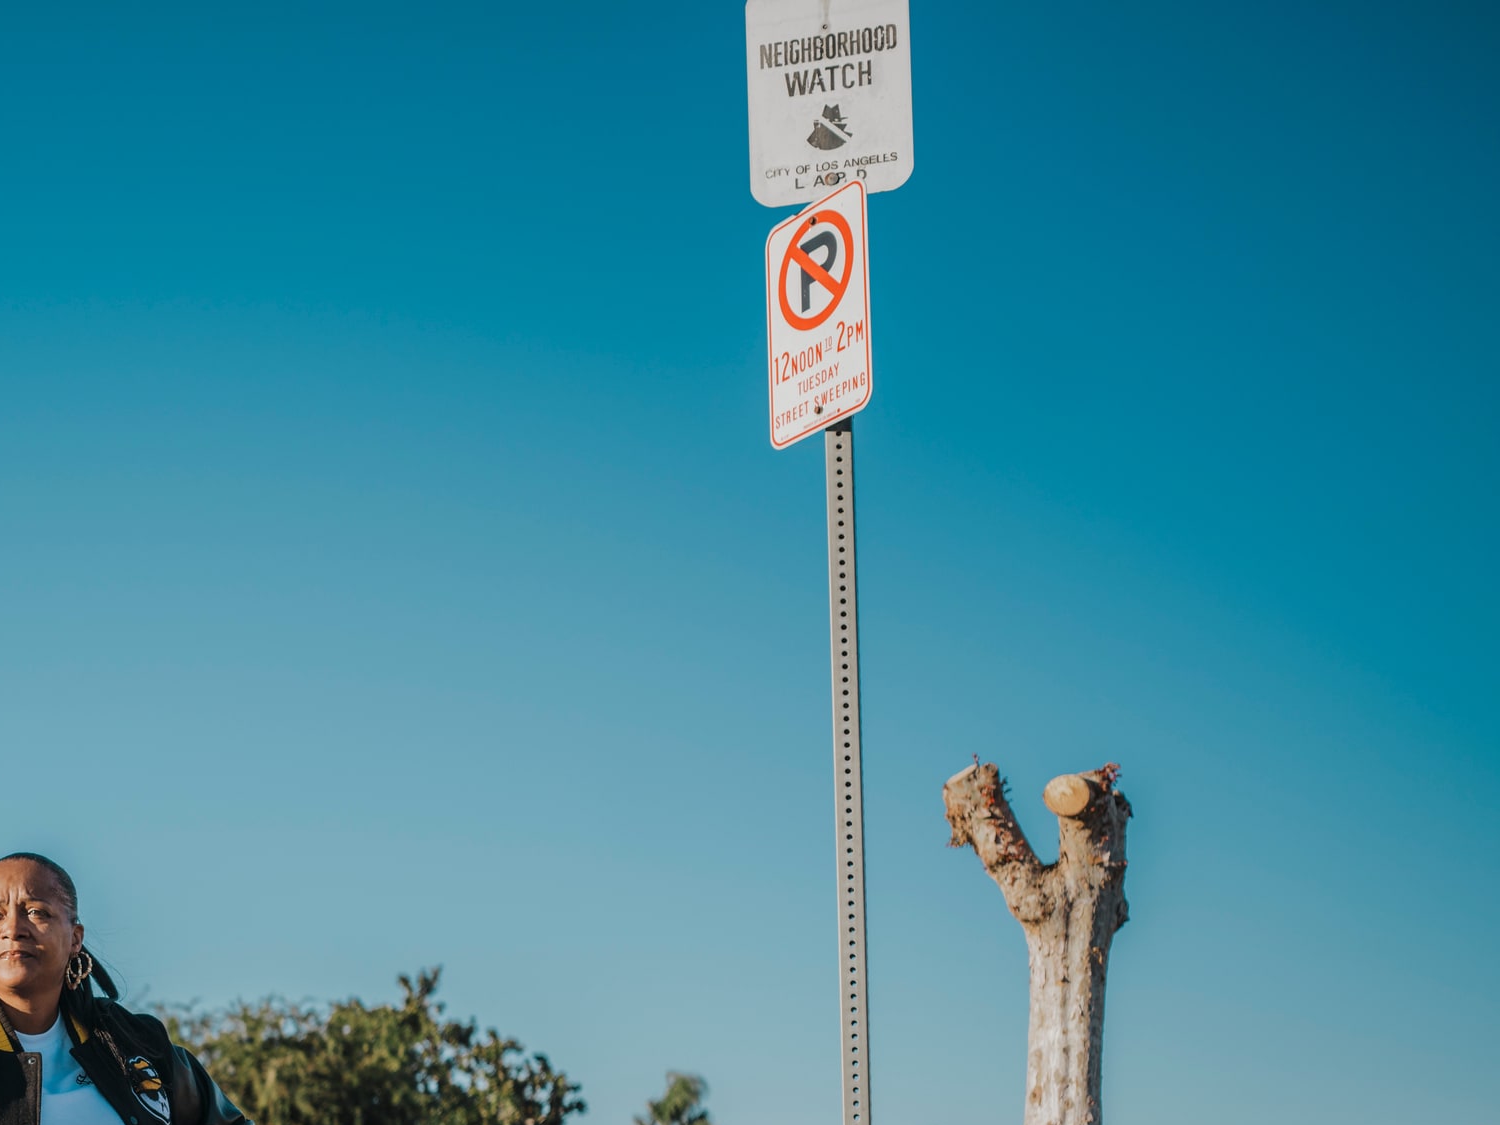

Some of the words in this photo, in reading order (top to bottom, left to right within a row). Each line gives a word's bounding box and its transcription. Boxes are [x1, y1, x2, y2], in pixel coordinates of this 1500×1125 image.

[759, 24, 897, 70] NEIGHBORHOOD
[785, 59, 873, 97] WATCH
[765, 167, 790, 180] CITY
[795, 164, 811, 175] OF
[816, 160, 839, 172] LOS
[844, 152, 898, 168] ANGELES
[798, 361, 840, 395] TUESDAY
[775, 400, 809, 429] STREET
[814, 371, 866, 409] SWEEPING
